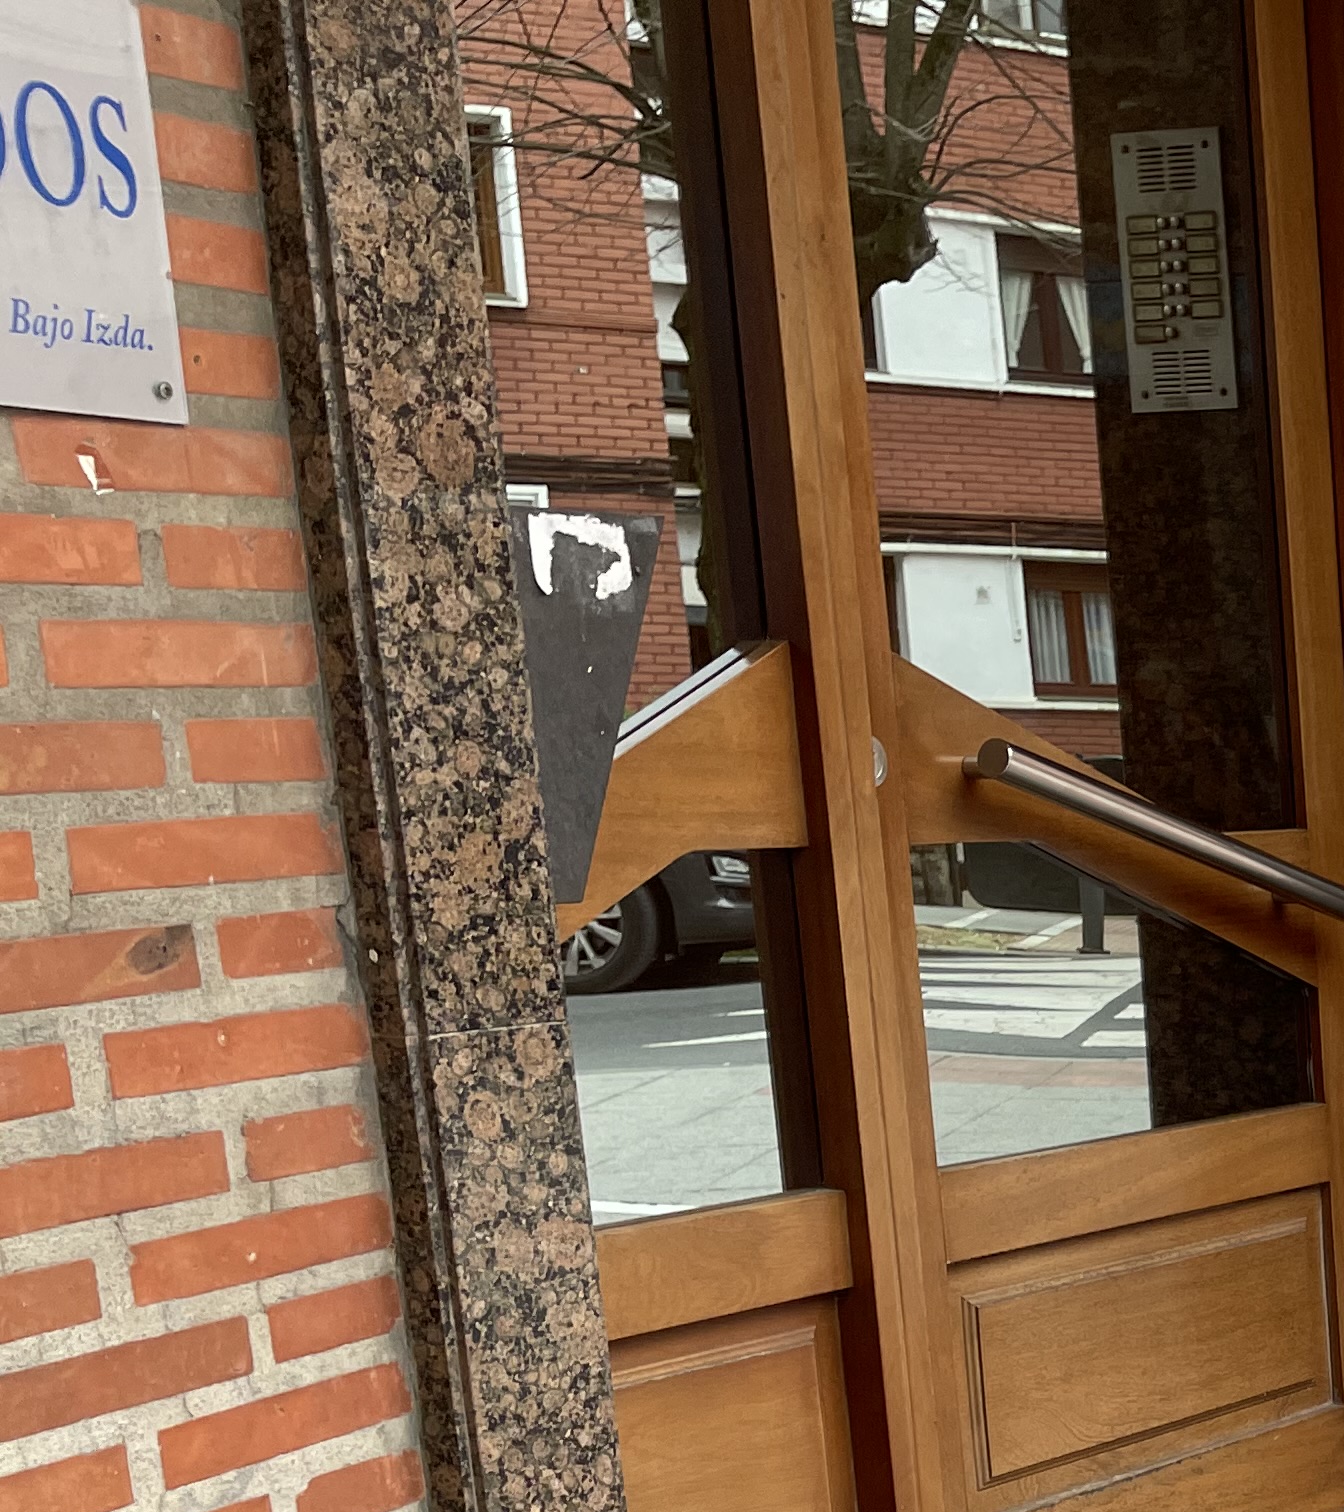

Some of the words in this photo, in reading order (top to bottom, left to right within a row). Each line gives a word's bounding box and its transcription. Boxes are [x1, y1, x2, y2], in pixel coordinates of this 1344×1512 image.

[0, 80, 137, 218] OS
[9, 297, 73, 348] Bajo
[81, 308, 154, 351] Izda.
